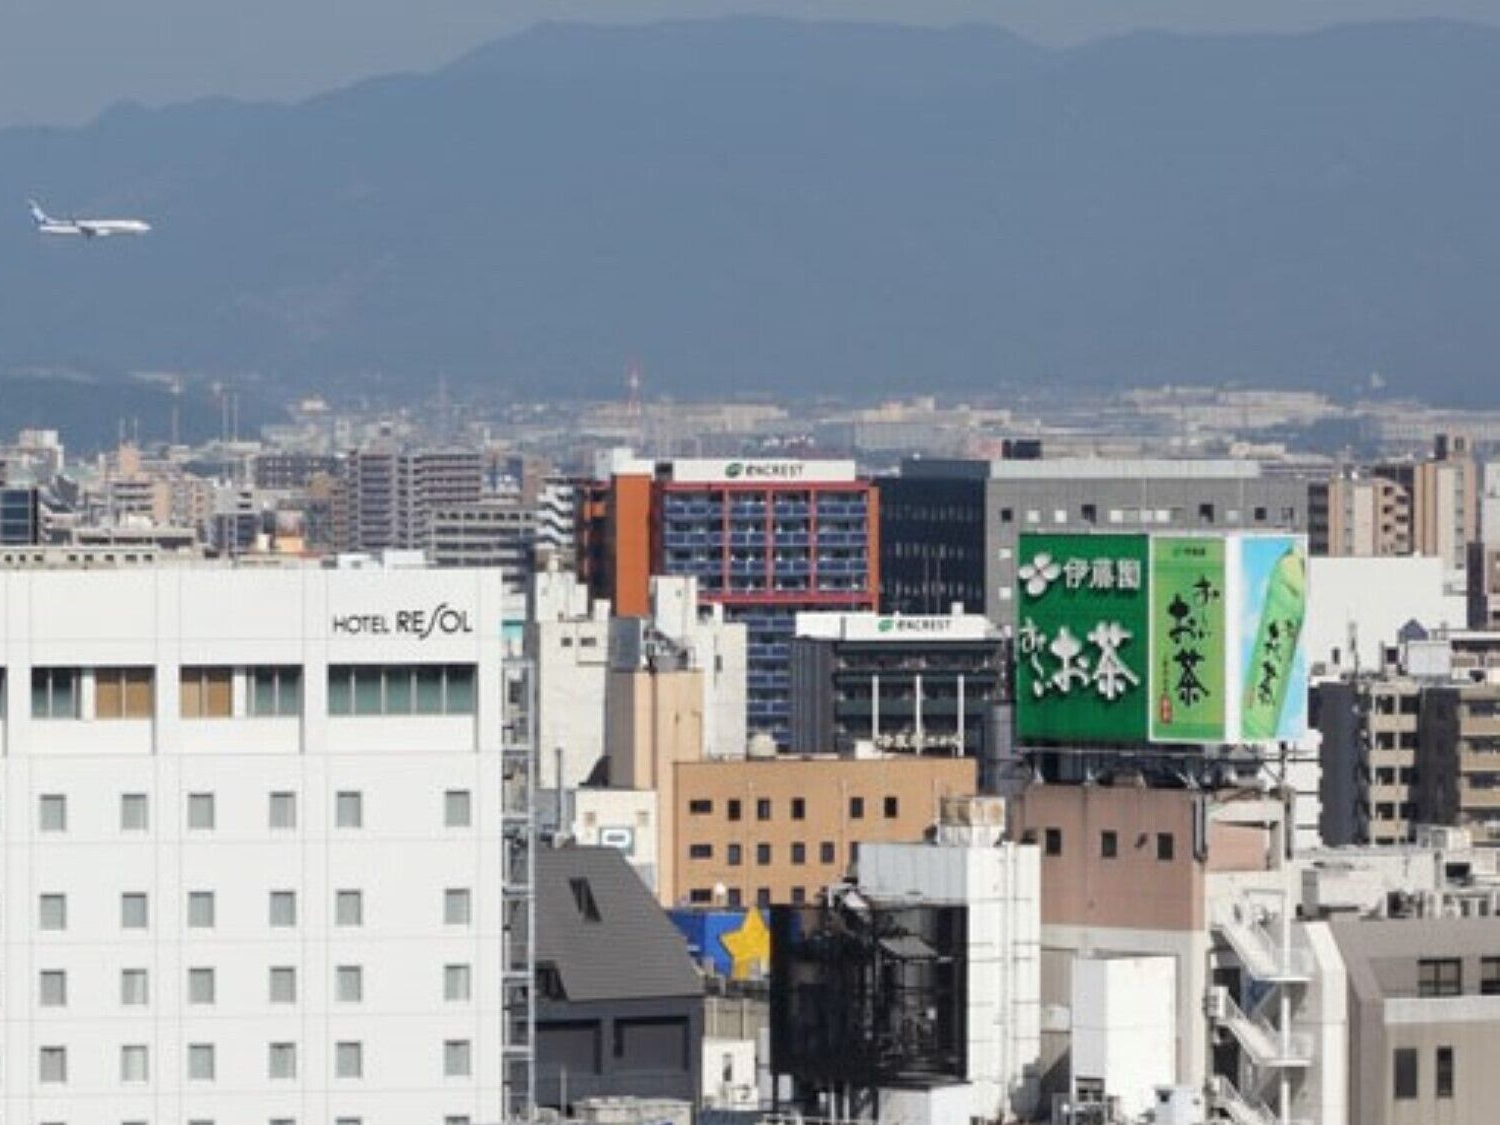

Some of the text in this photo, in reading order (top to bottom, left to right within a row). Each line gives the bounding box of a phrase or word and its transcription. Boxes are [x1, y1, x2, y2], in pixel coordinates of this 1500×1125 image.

[1063, 558, 1141, 589] 伊藤園
[333, 602, 473, 641] HOTEL RESOL
